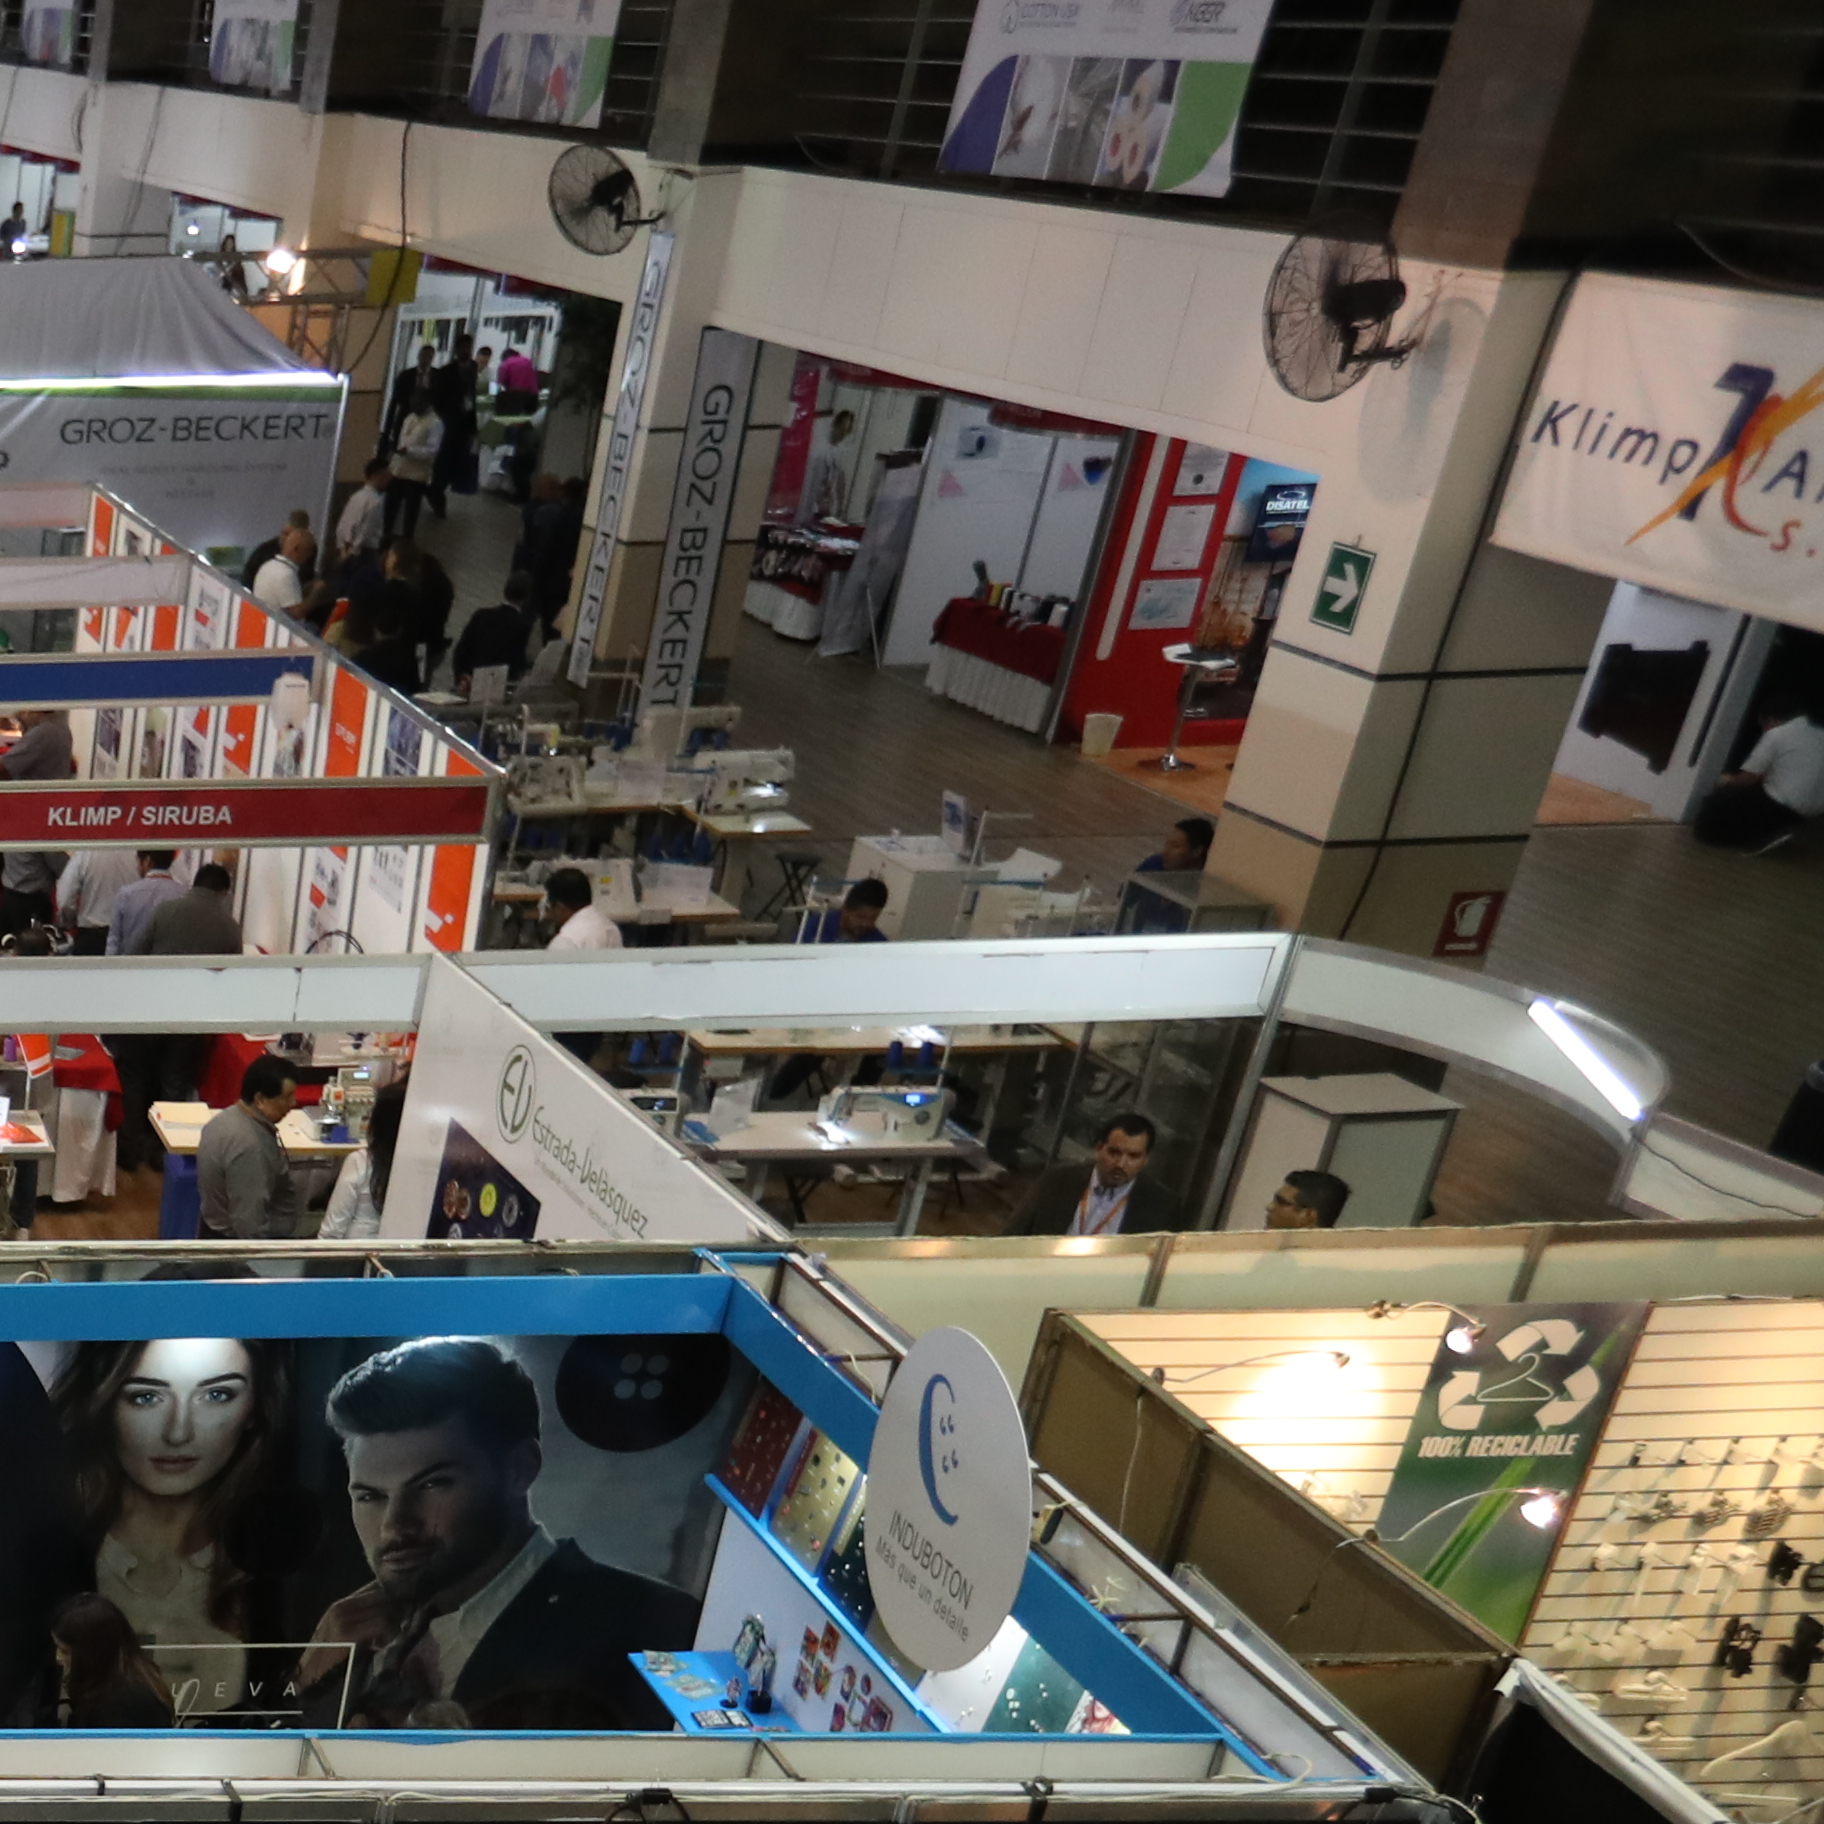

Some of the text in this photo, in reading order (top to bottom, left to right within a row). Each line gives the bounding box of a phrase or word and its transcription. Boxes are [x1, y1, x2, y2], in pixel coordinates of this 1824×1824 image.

[59, 412, 328, 446] GROZ-BECKERT
[1530, 399, 1701, 486] Klimp
[1265, 499, 1311, 513] DISATEL
[46, 806, 123, 829] KLIMP
[140, 804, 233, 828] SIRUBA
[1417, 1432, 1581, 1459] 100% RECICLABLE
[888, 1508, 975, 1612] INDUBOTON
[874, 1535, 970, 1644] Más que un detalle
